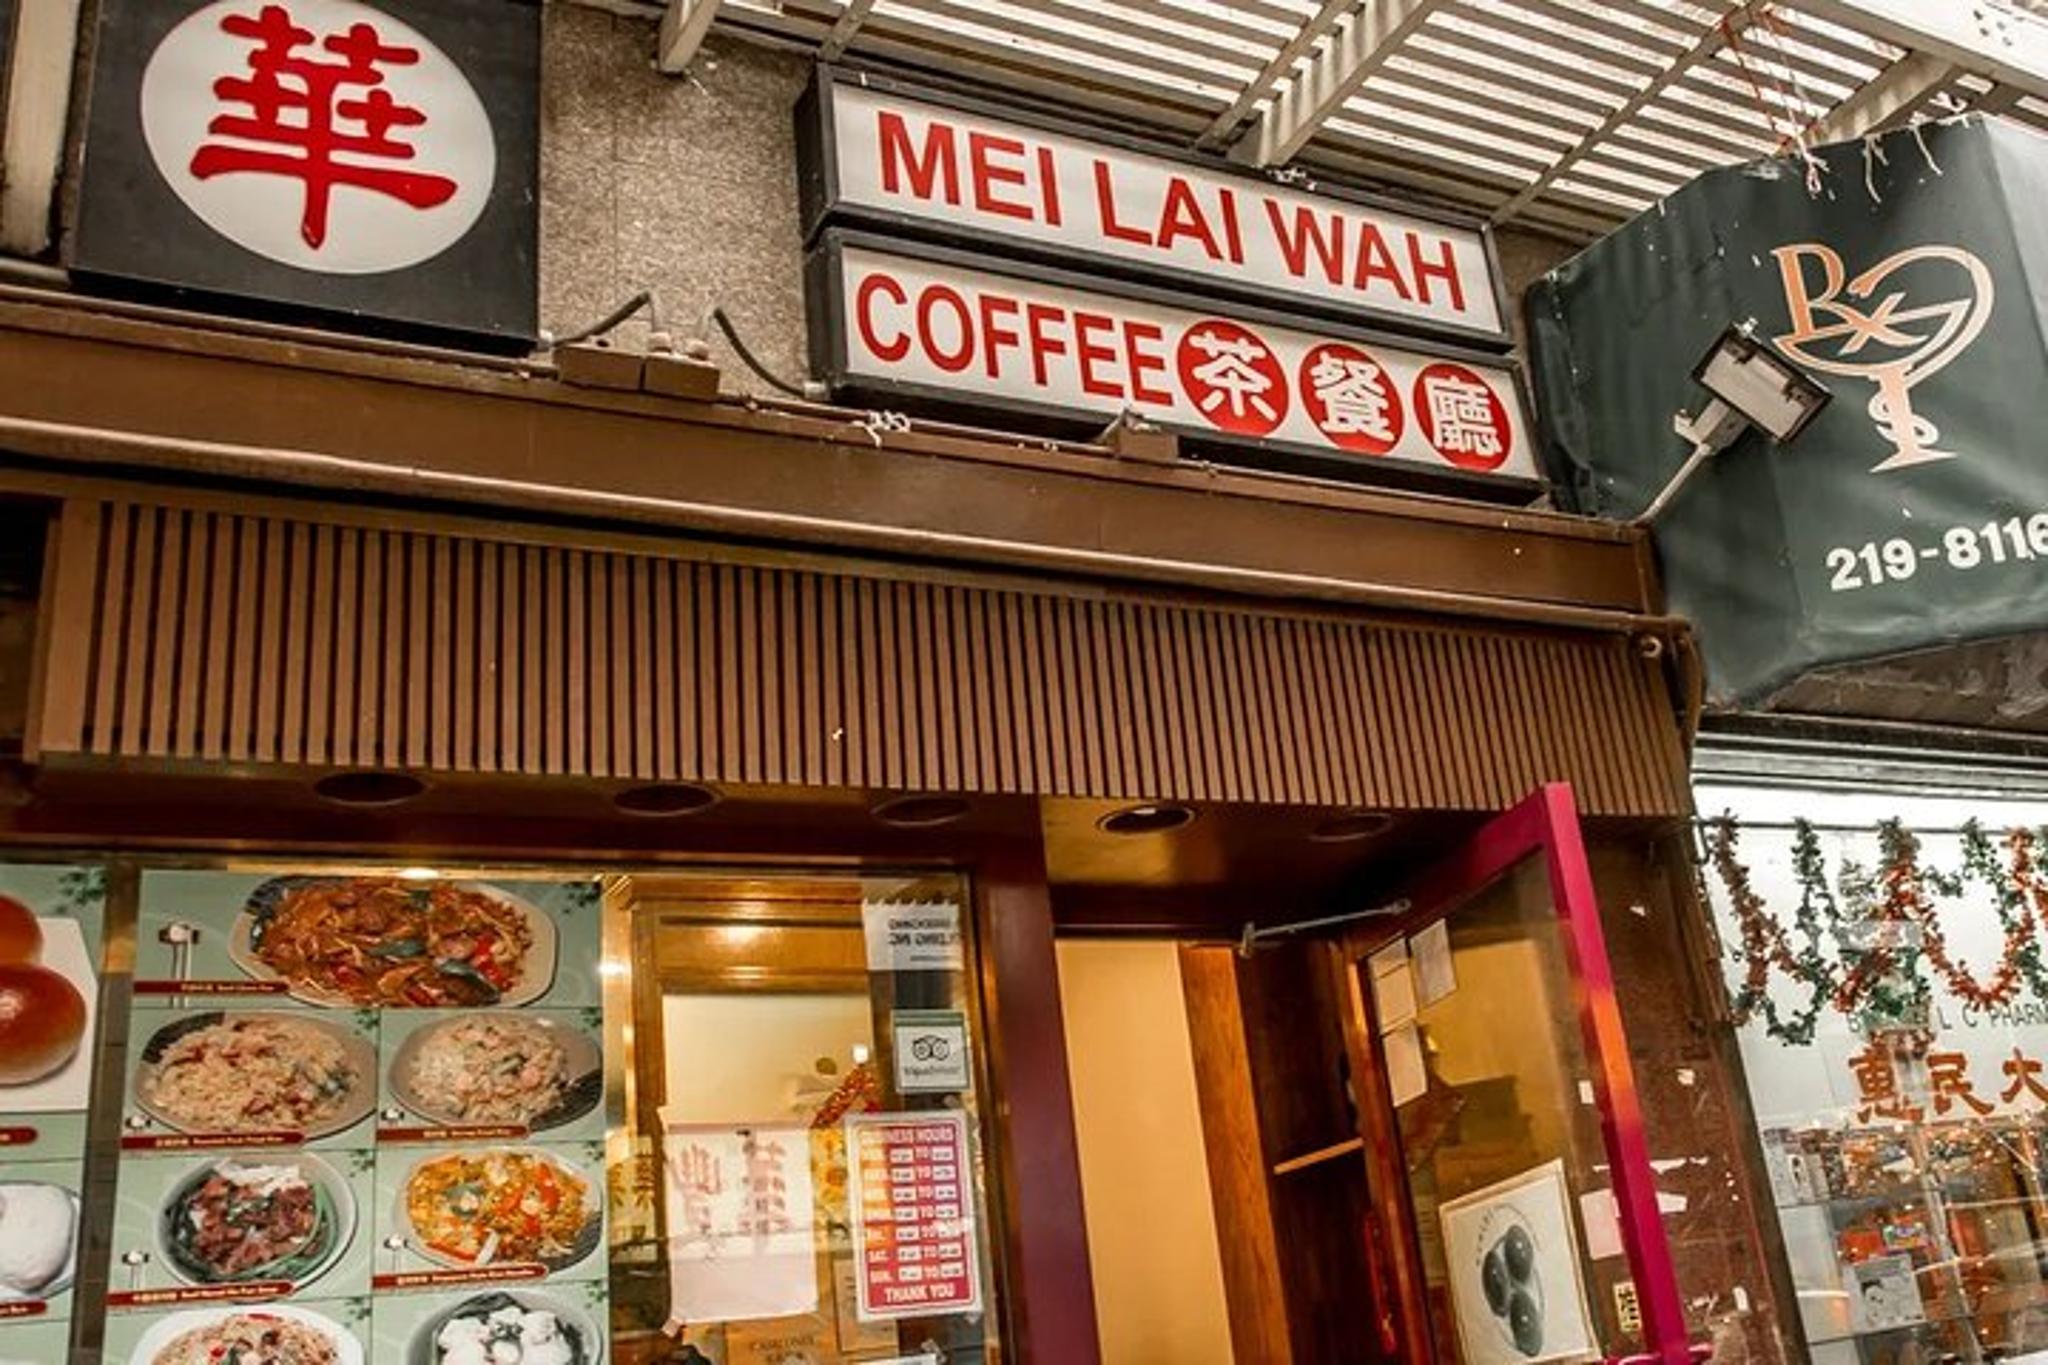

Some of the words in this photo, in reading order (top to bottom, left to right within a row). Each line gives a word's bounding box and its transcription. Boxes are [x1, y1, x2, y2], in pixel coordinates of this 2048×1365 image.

[190, 5, 458, 249] 華
[879, 109, 1063, 227] MEI
[1094, 159, 1243, 265] LAI
[1264, 198, 1466, 311] WAH
[857, 272, 1173, 407] COFFEE
[1190, 327, 1506, 462] 茶餐廳
[1826, 513, 2048, 592] 219-8116
[884, 1286, 929, 1303] THANK
[929, 1282, 956, 1299] YOU
